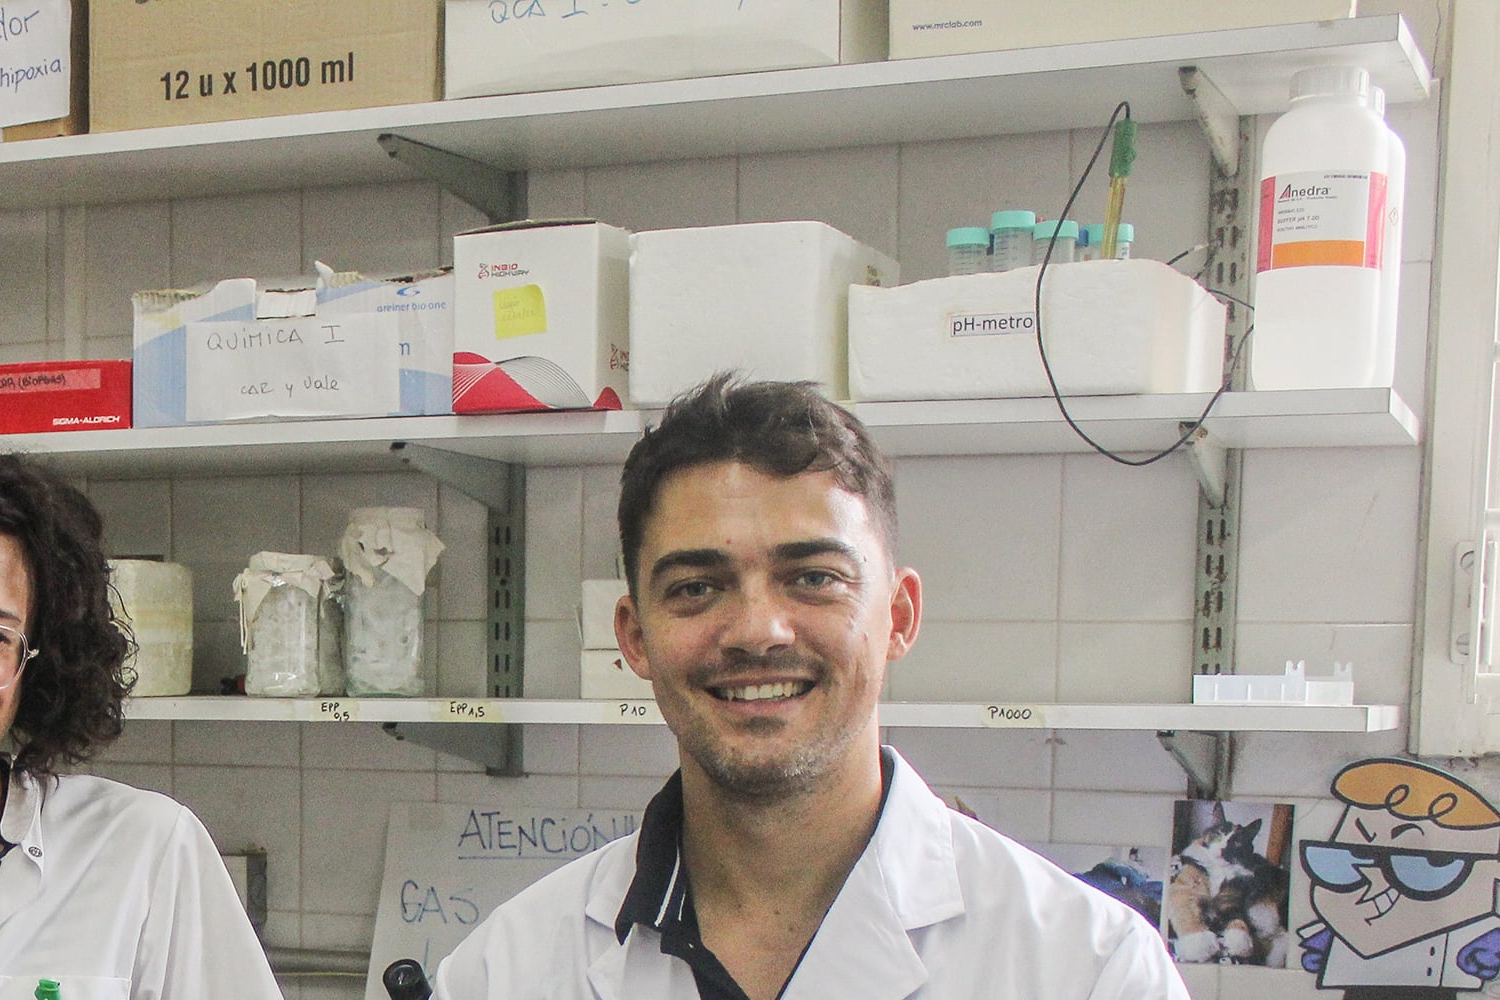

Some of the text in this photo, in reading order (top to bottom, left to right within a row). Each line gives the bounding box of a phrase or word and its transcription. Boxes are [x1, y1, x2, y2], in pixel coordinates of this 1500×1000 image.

[0, 57, 64, 88] hipoxia
[160, 52, 355, 101] 12 u x 1000 ml
[1278, 184, 1330, 200] Anedra
[953, 315, 1033, 335] pH-metro
[206, 324, 346, 351] QUIMICA I
[52, 415, 121, 426] SIGMA-ALDRICH
[321, 702, 339, 712] EPP
[450, 701, 468, 715] EPP
[987, 705, 1032, 720] P1000
[400, 879, 481, 925] GAS
